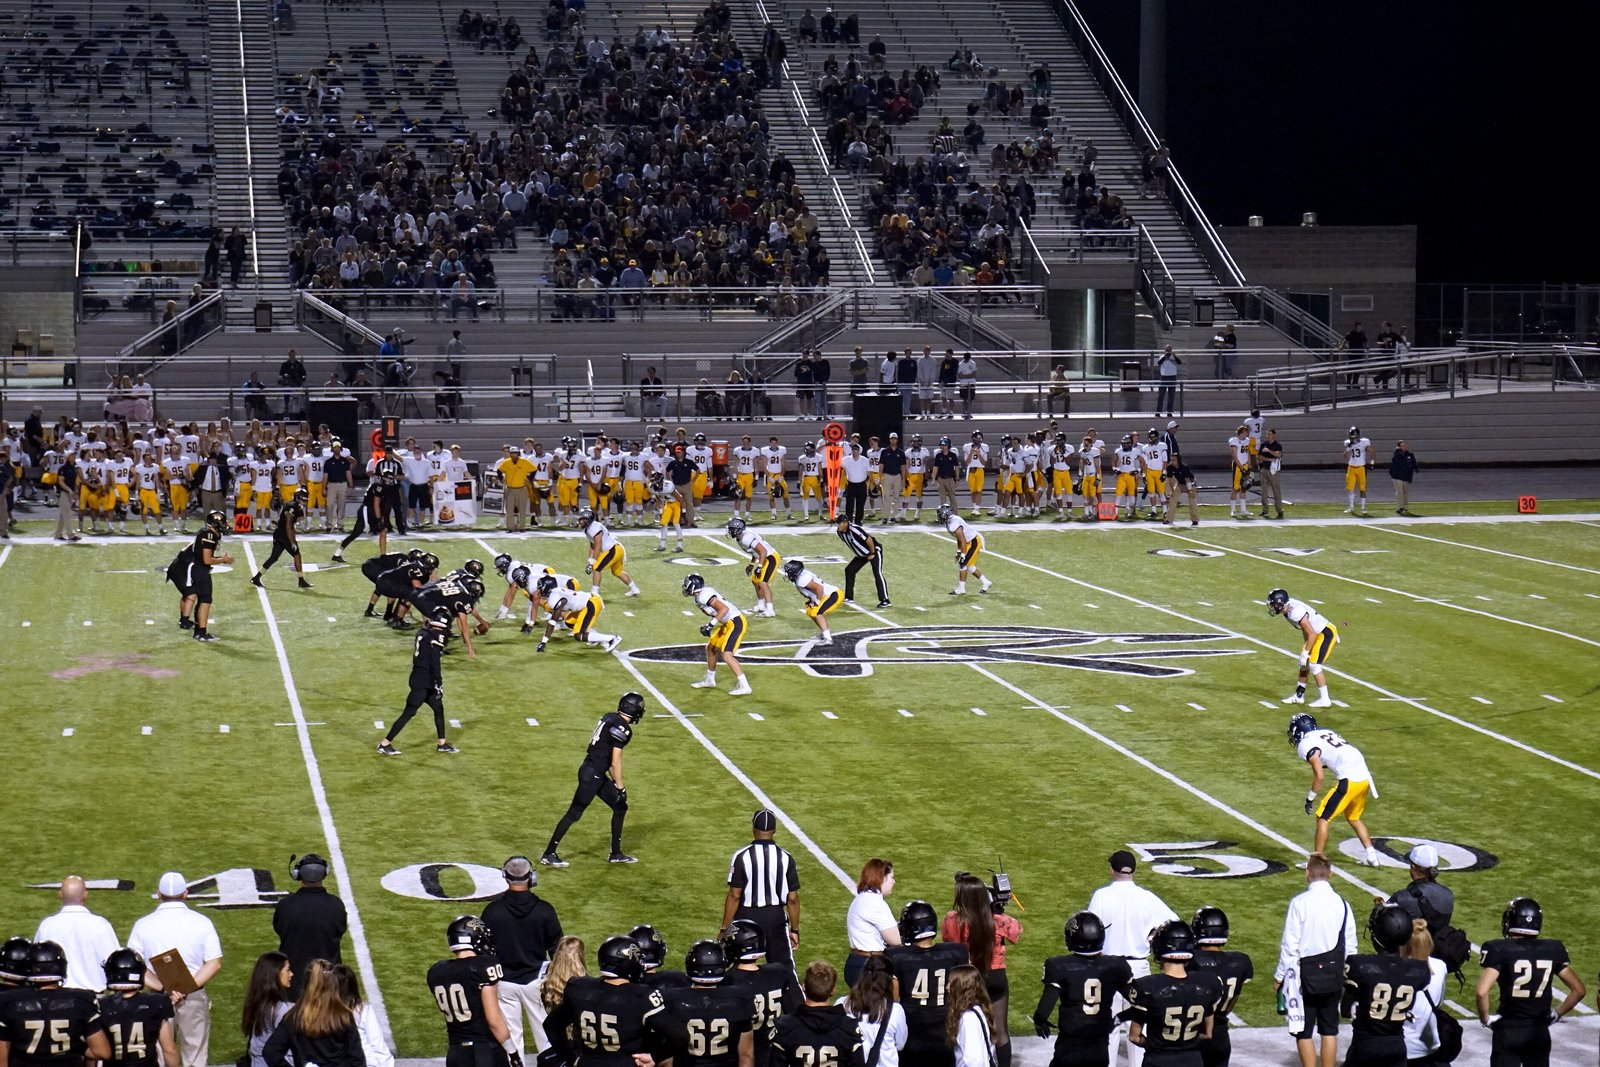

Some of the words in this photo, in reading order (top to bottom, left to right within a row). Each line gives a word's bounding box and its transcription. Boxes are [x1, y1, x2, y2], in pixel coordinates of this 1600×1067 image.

[1255, 423, 1261, 433] 3
[186, 442, 197, 453] 50
[1351, 449, 1361, 458] 13
[694, 455, 706, 464] 90
[741, 456, 750, 466] 31
[770, 456, 780, 465] 21
[1122, 456, 1132, 466] 16
[171, 466, 183, 477] 95
[283, 465, 295, 476] 52
[311, 462, 321, 472] 91
[591, 465, 602, 475] 48
[628, 461, 639, 471] 96
[806, 463, 817, 472] 87
[116, 467, 129, 478] 28
[144, 473, 155, 482] 24
[1521, 497, 1536, 511] 30
[1101, 504, 1115, 517] 40
[236, 516, 251, 530] 40
[438, 634, 446, 644] 5
[486, 963, 504, 982] 90
[1511, 959, 1553, 998] 27
[911, 968, 947, 1006] 41
[1082, 977, 1102, 1016] 9
[1366, 982, 1411, 1021] 82
[434, 982, 472, 1023] 90
[1162, 1004, 1205, 1041] 52
[579, 1009, 621, 1052] 65
[25, 1019, 71, 1055] 75
[109, 1020, 147, 1060] 14
[686, 1017, 730, 1057] 62
